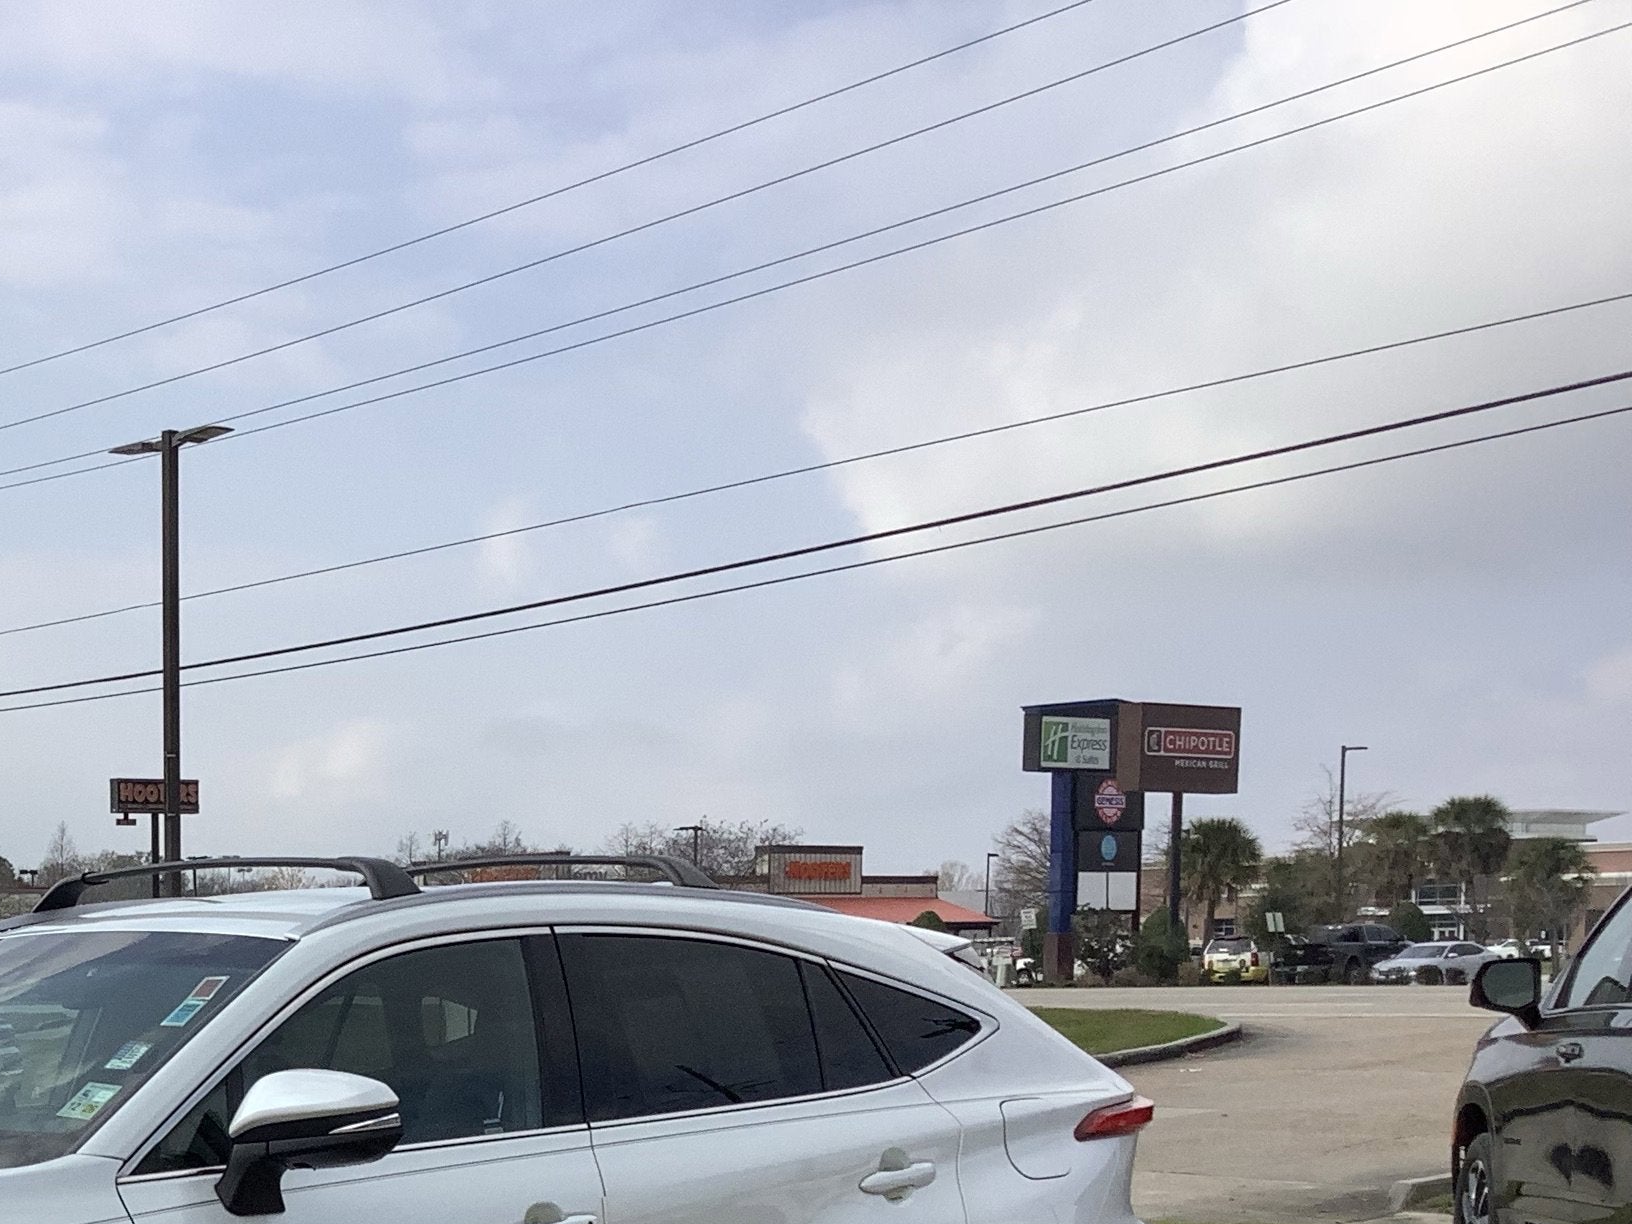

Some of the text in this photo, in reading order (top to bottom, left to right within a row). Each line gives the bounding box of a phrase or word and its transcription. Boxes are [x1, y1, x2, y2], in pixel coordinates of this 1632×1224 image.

[1071, 734, 1107, 753] Express
[1166, 735, 1231, 752] CHIPOTLE
[1174, 759, 1207, 769] MEXICAN
